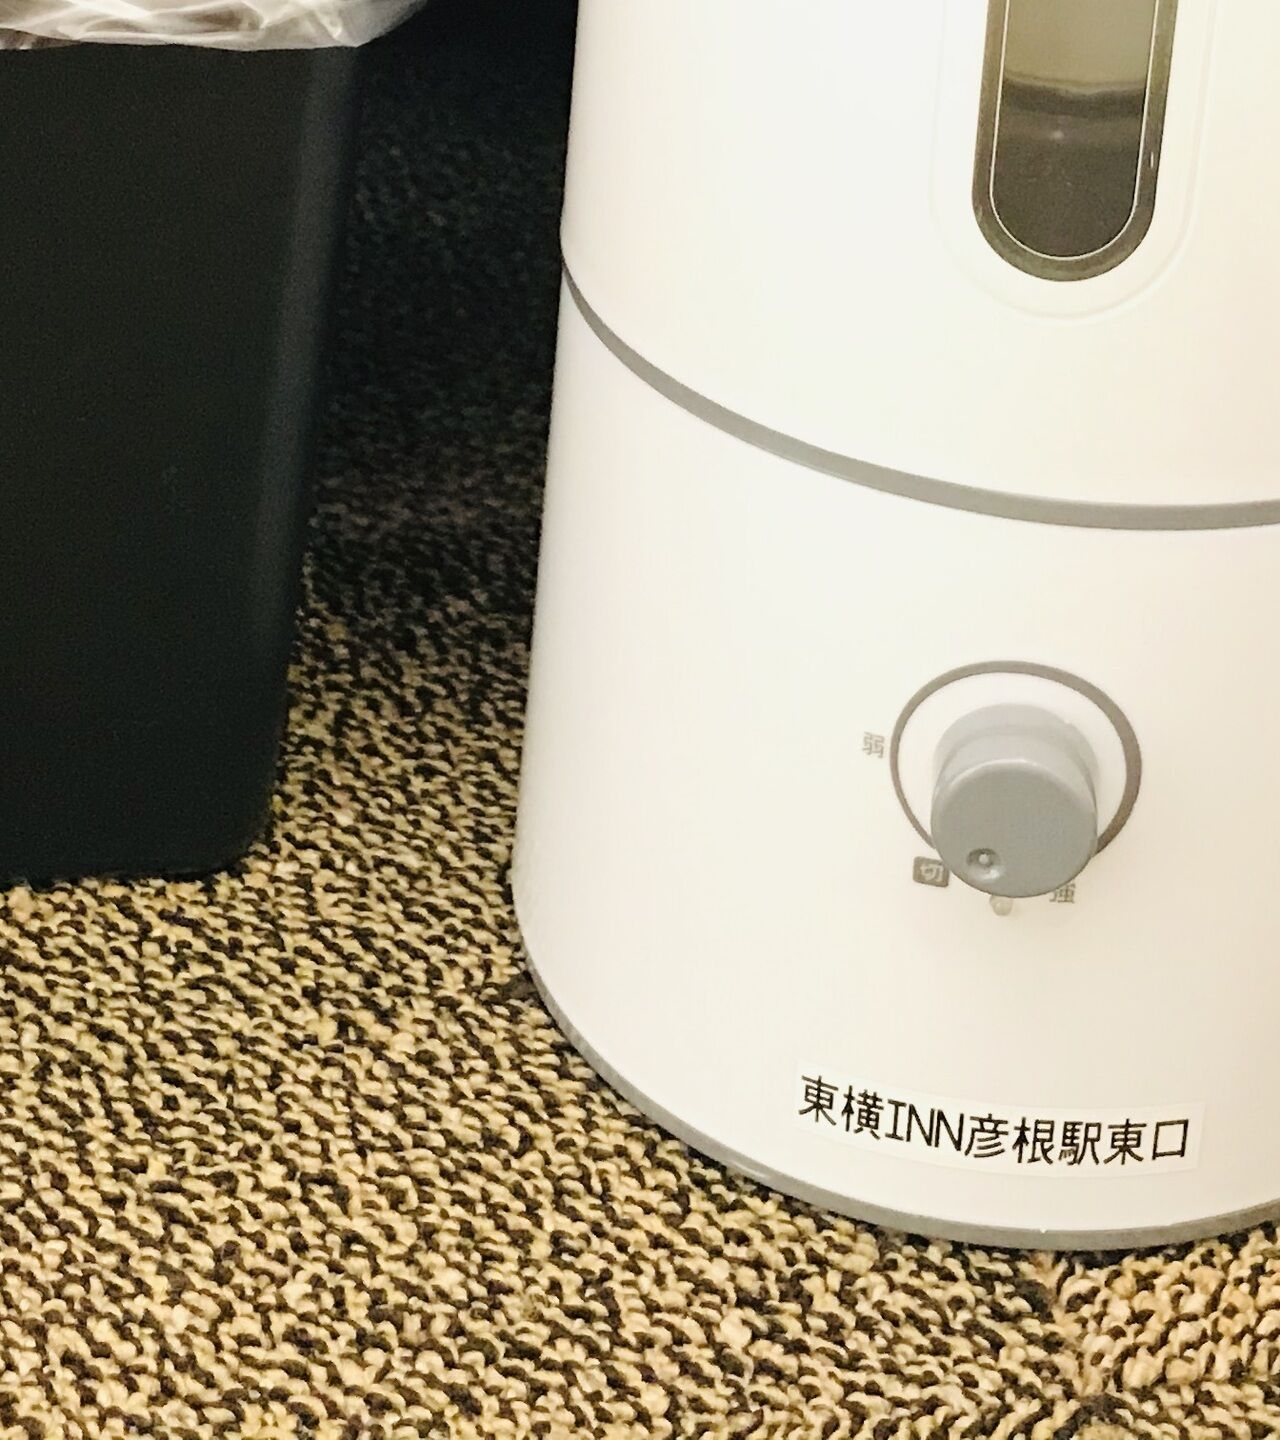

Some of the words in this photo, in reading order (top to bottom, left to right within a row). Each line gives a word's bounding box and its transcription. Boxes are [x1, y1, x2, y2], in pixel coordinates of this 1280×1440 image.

[862, 731, 884, 757] 弱
[921, 861, 945, 882] 切
[798, 1075, 1189, 1165] 東横INN彦根駅東口
